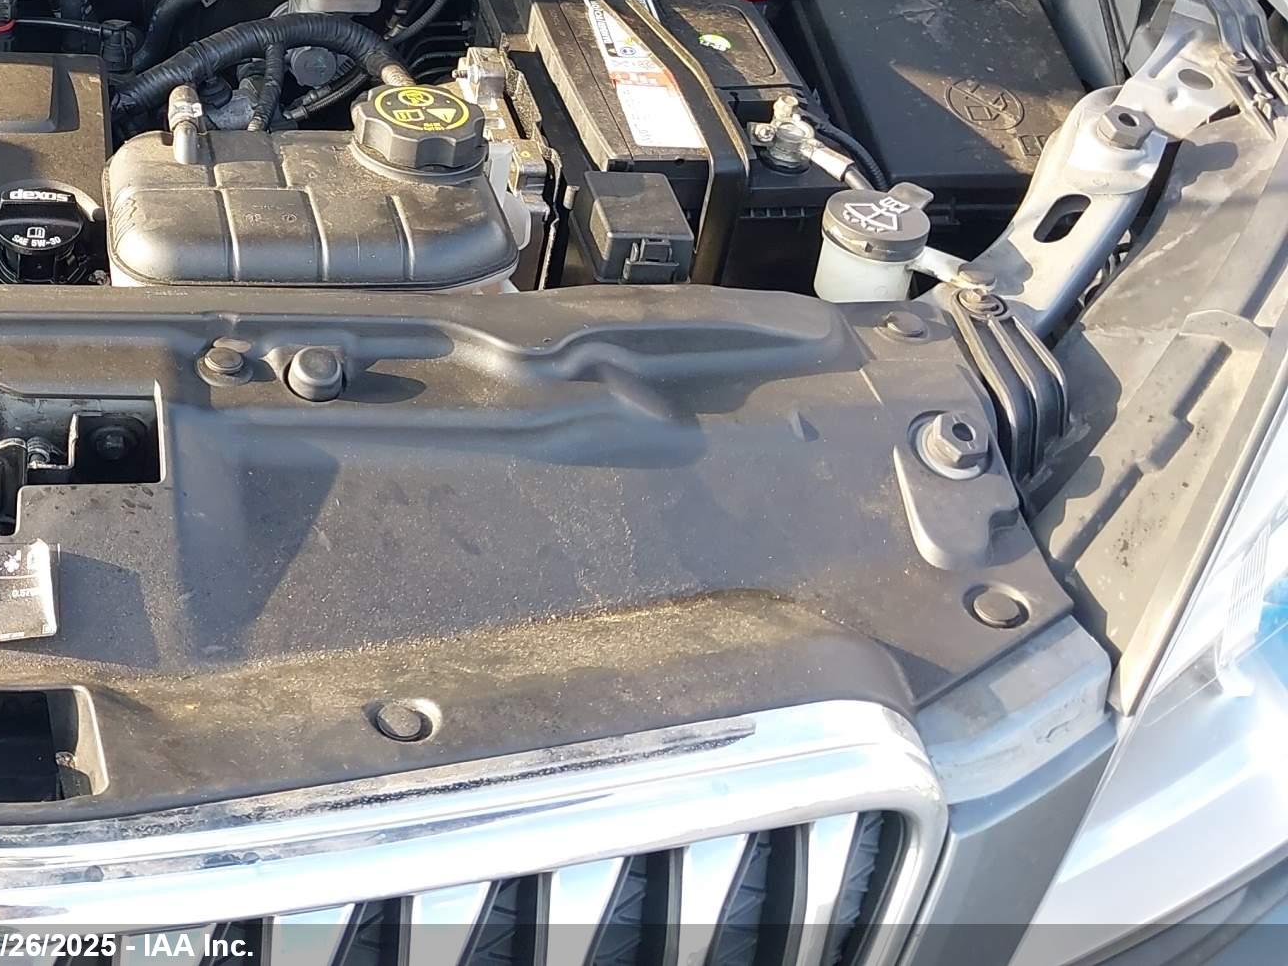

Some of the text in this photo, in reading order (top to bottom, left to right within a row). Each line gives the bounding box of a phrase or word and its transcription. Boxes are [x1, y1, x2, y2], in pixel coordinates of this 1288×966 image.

[9, 188, 69, 202] dexos
[11, 234, 62, 248] SAE 5W-30
